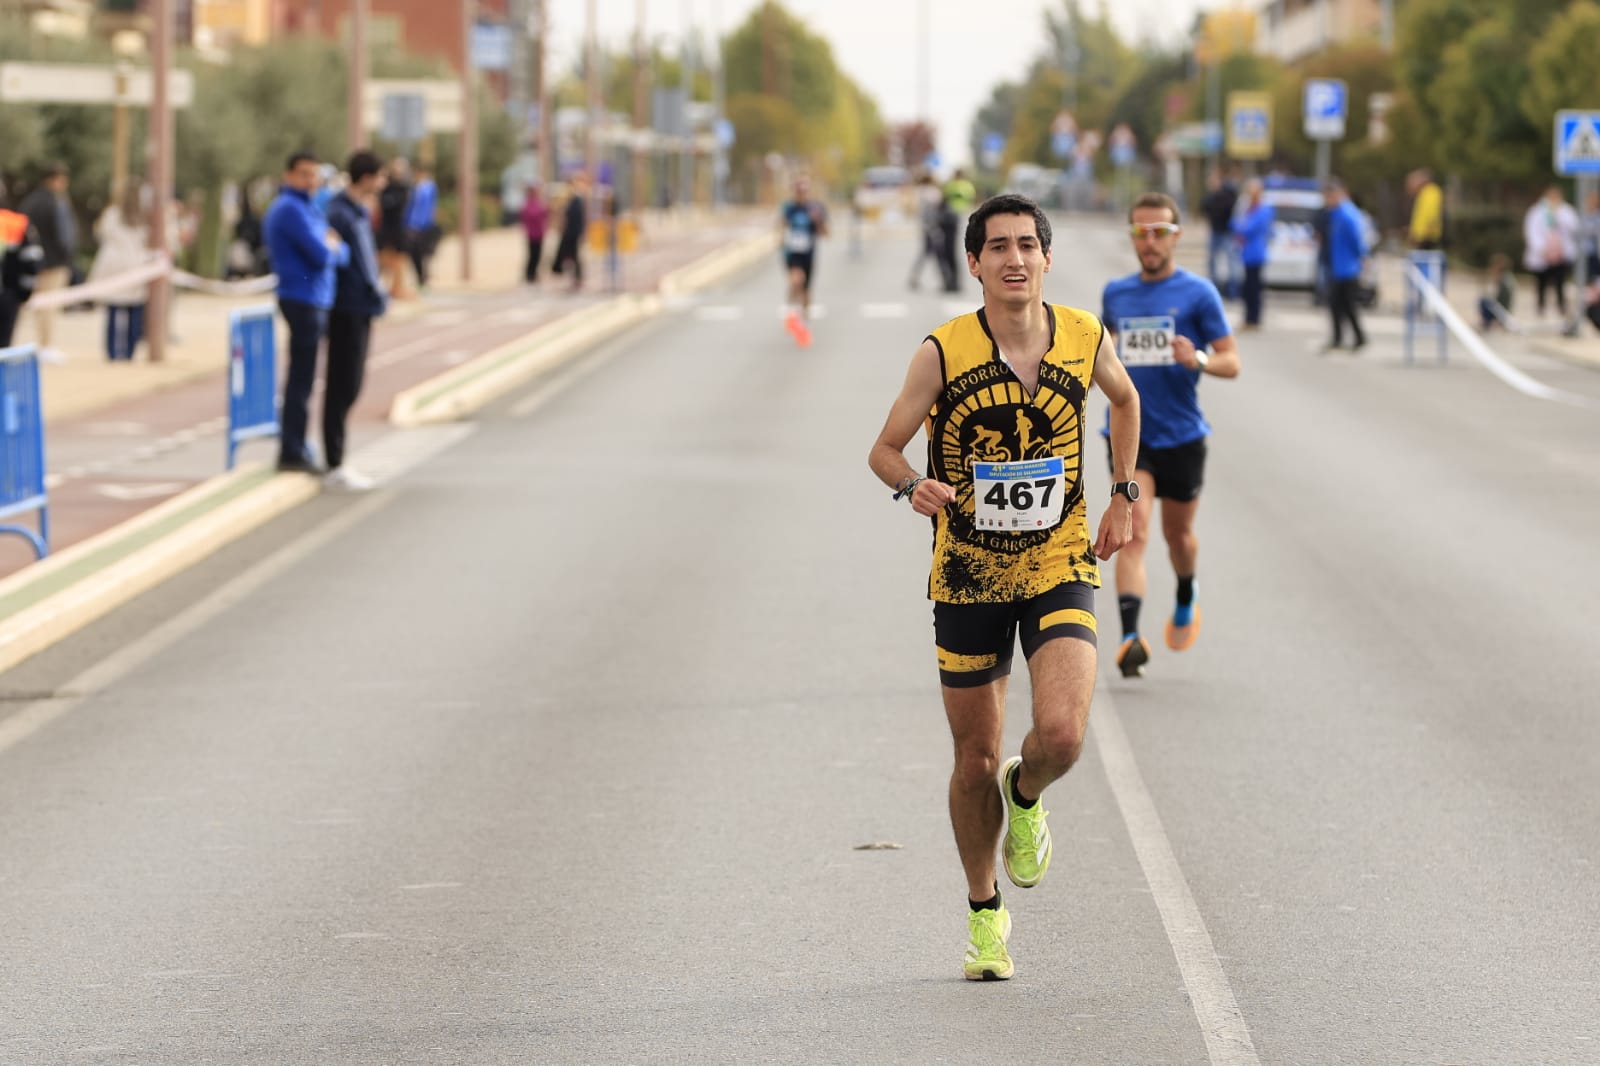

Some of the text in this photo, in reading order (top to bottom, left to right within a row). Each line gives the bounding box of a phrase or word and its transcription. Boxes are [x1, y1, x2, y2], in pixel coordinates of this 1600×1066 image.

[1127, 330, 1168, 350] 480
[984, 477, 1057, 510] 467
[967, 529, 985, 544] LA
